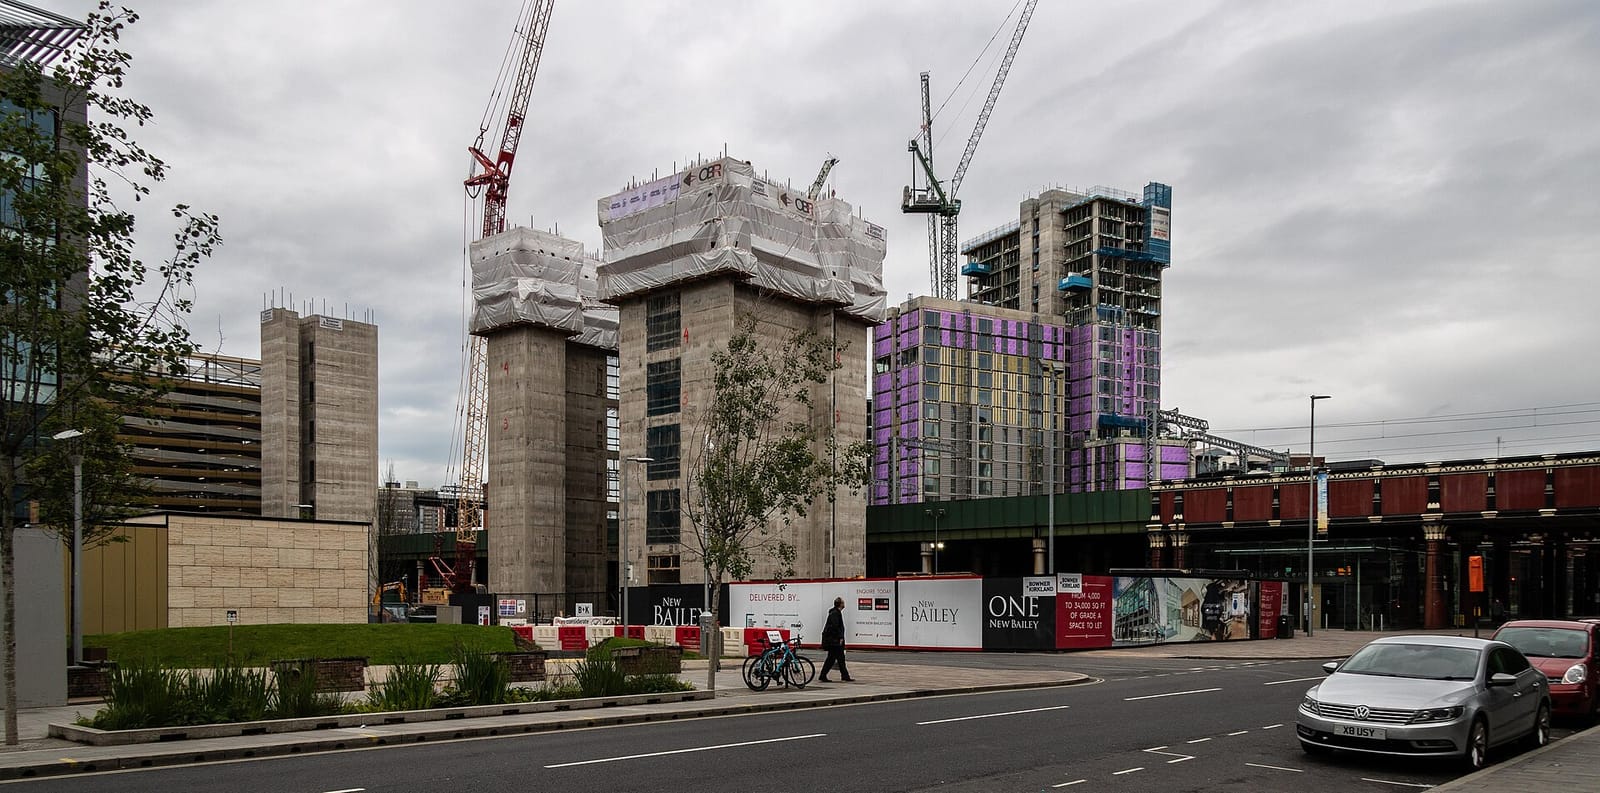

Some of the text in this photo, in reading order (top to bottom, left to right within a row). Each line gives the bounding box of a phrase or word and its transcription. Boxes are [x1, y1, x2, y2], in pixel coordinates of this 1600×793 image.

[699, 164, 721, 181] OBR
[683, 328, 689, 343] 4
[504, 361, 509, 375] 4
[749, 593, 785, 602] DELIVERED
[577, 606, 590, 614] B+K
[989, 595, 1039, 617] ONE
[1356, 727, 1375, 737] USY
